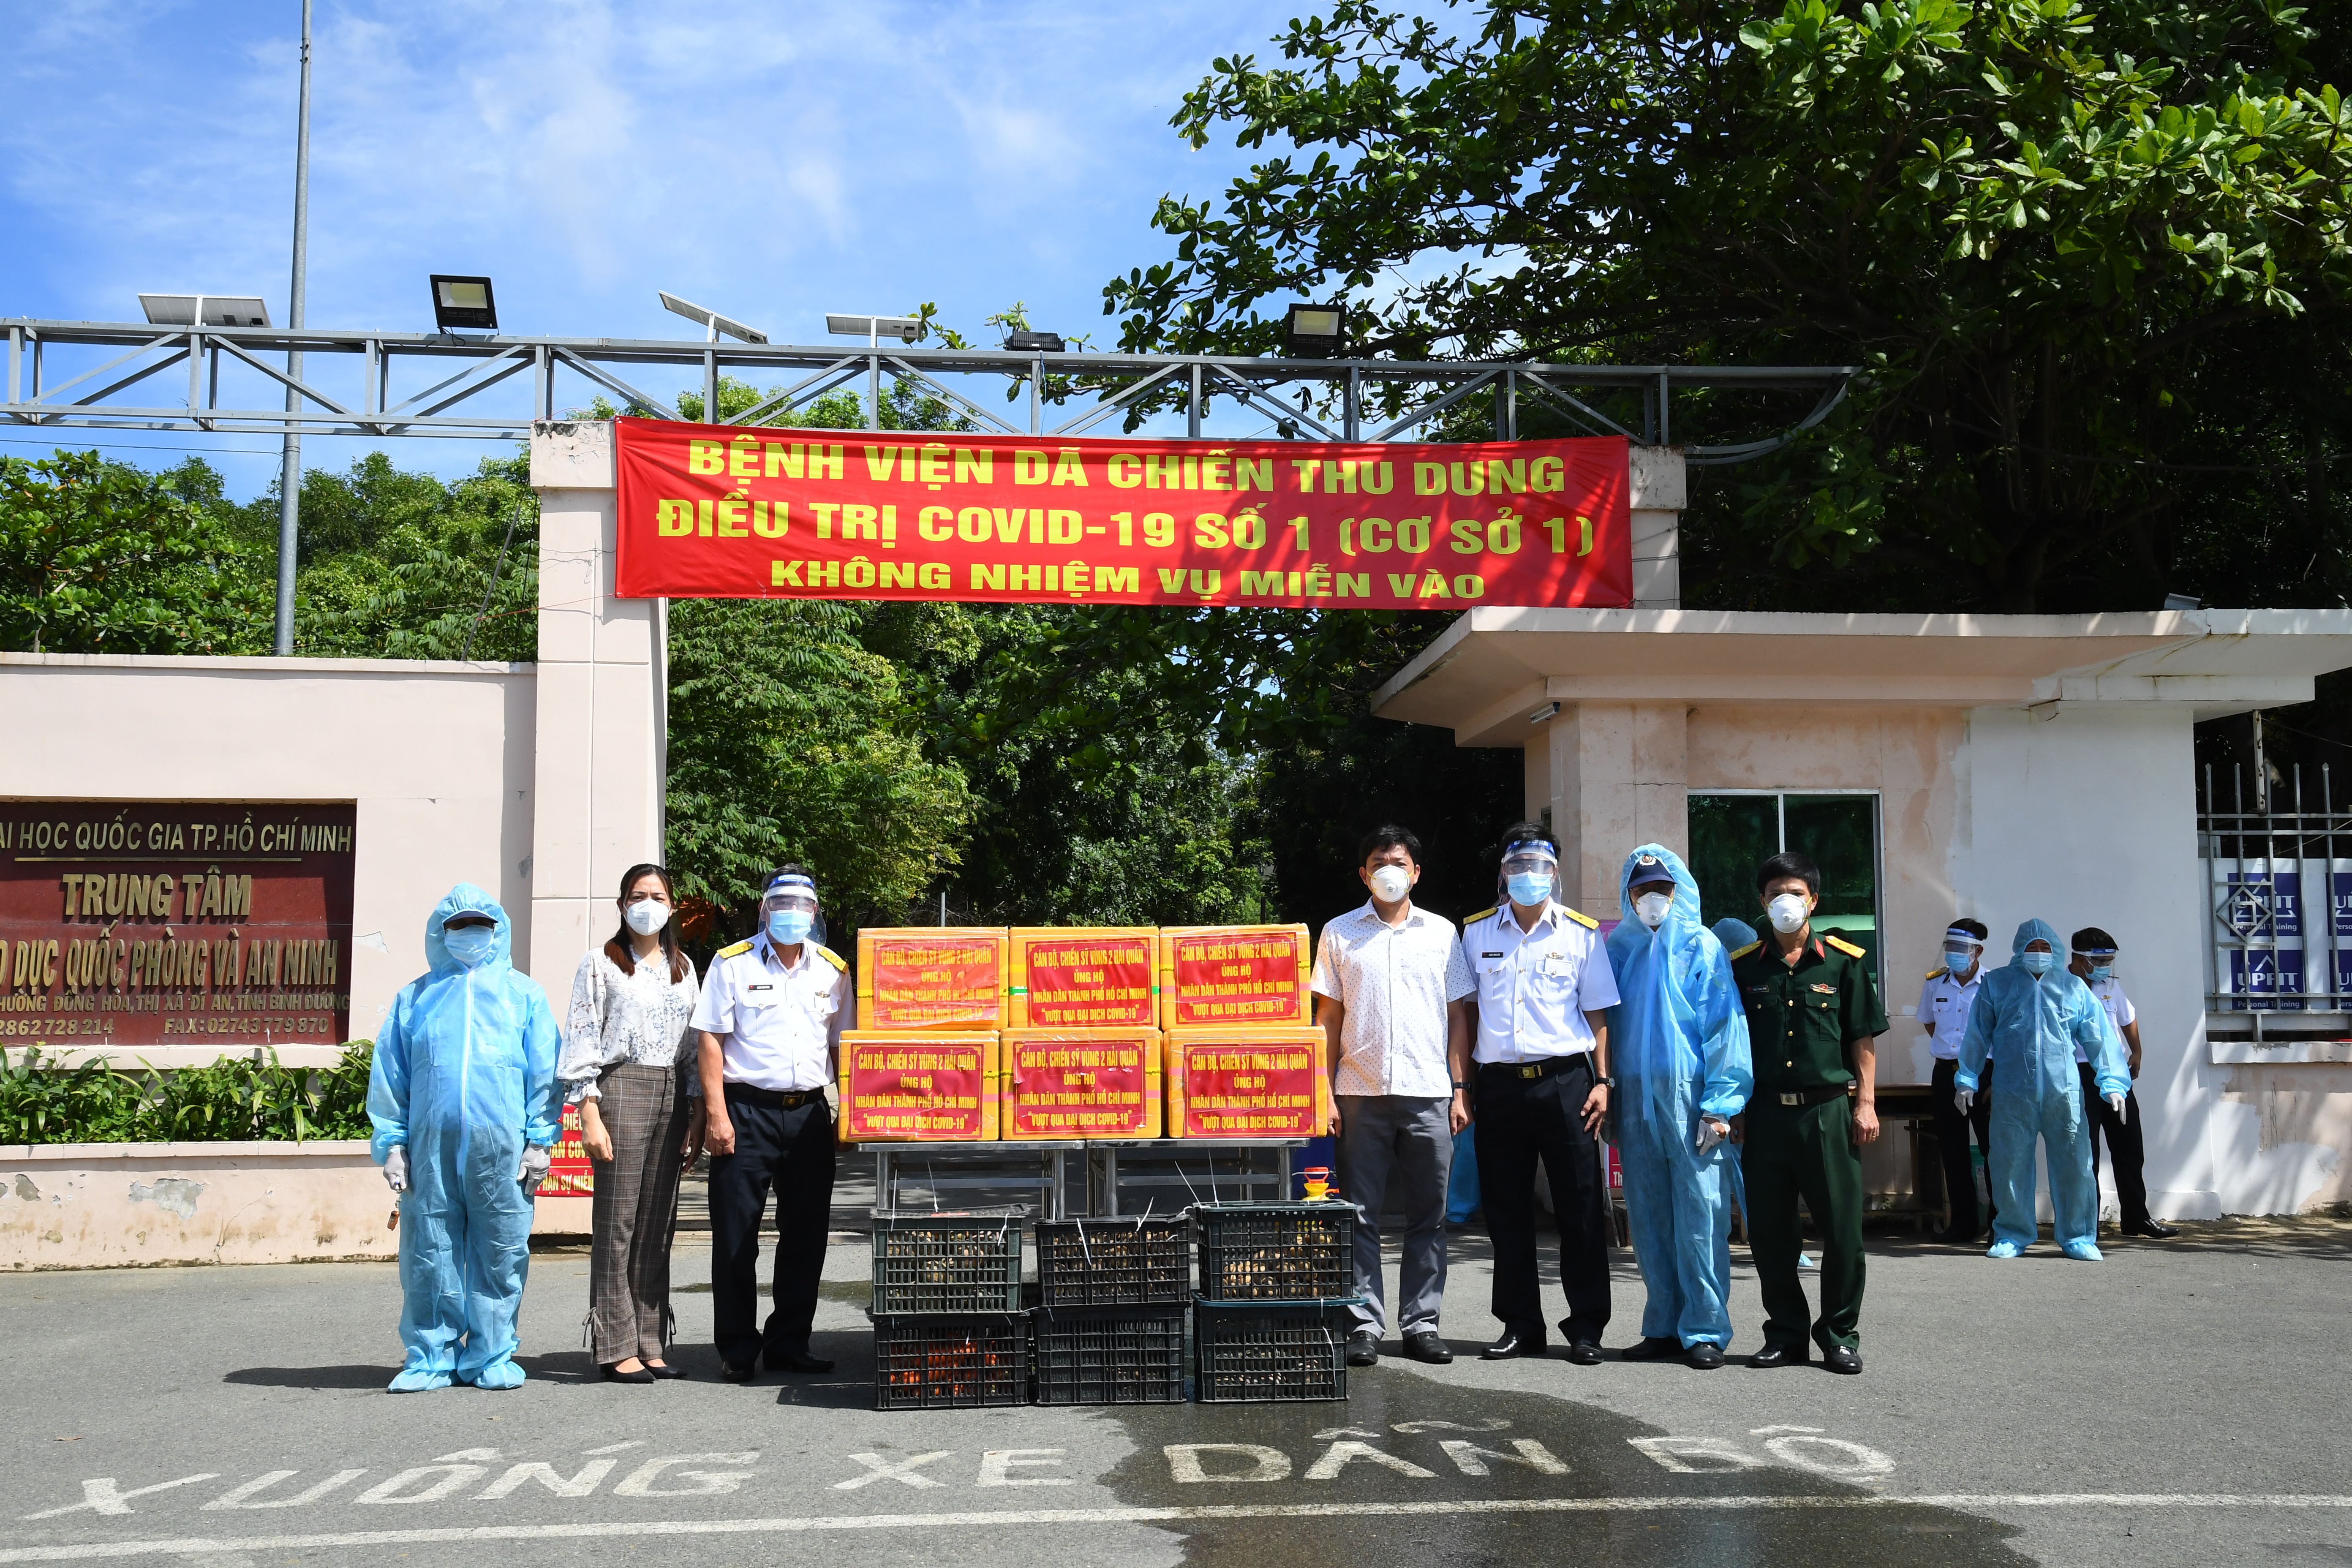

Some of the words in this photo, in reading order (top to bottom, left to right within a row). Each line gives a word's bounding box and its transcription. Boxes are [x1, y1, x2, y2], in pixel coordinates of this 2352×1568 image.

[690, 434, 843, 484] BỆNH
[864, 443, 993, 490] VIỆN
[1015, 446, 1088, 486] DÃ
[1108, 449, 1273, 491] CHIẾN
[1292, 460, 1393, 494] THU
[1414, 457, 1564, 495] DUNG
[656, 490, 788, 538] ĐIỀU
[809, 504, 896, 548] TRỊ
[919, 507, 1174, 547] COVID-19
[1195, 503, 1267, 550] SỐ
[1288, 517, 1309, 550] 1
[1339, 516, 1431, 556] (CƠ
[1451, 507, 1522, 554] SỞ
[1543, 517, 1592, 556] 1)
[772, 556, 950, 589] KHÔNG
[971, 561, 1139, 597] NHIỆM
[1157, 569, 1221, 600] VỤ
[1241, 564, 1370, 597] MIỄN
[1387, 569, 1484, 598] VÀO
[19, 822, 69, 855] HỌC
[76, 808, 143, 850] QUỐC
[148, 822, 184, 850] GIA
[261, 817, 300, 851] CHÍ
[300, 825, 351, 852] MINH
[63, 873, 173, 916] TRUNG
[182, 865, 252, 916] TÂM
[14, 939, 59, 995] DỤC
[66, 919, 125, 994] QUỐC
[131, 927, 207, 986] PHÒNG
[215, 928, 239, 985] VÀ
[245, 940, 279, 985] AN
[284, 939, 338, 985] NINH
[1034, 950, 1047, 967] CÁN
[1048, 949, 1059, 969] BỘ,
[1060, 946, 1079, 966] CHIẾN
[1081, 948, 1089, 966] SỸ
[1090, 947, 1107, 965] VÙNG
[1108, 950, 1112, 964] 2
[1114, 945, 1124, 964] HẢI
[1126, 946, 1143, 966] QUÂN
[1181, 943, 1195, 961] CÁN
[1208, 940, 1227, 961] CHIẾN
[1256, 944, 1259, 958] 2
[1261, 938, 1271, 958] HẢI
[1273, 939, 1290, 958] QUÂN
[1074, 969, 1091, 983] ỦNG
[1093, 969, 1104, 984] HỘ
[1222, 963, 1239, 977] ỦNG
[1241, 963, 1251, 978] HỘ
[270, 987, 302, 1010] BÌNH
[1033, 989, 1051, 1003] NHÂN
[1054, 988, 1067, 1002] DÂN
[1068, 988, 1089, 1002] THÀNH
[1092, 985, 1104, 1001] PHỐ
[1106, 985, 1115, 1000] HỒ
[1116, 986, 1127, 1000] CHÍ
[1129, 988, 1146, 999] MINH
[1181, 983, 1199, 996] NHÂN
[1201, 983, 1214, 996] DÂN
[1216, 982, 1237, 996] THÀNH
[1239, 979, 1252, 994] PHỐ
[1264, 980, 1275, 993] CHÍ
[1276, 981, 1293, 993] MINH
[1063, 1010, 1076, 1022] QUA
[1077, 1010, 1088, 1023] ĐẠI
[1090, 1009, 1105, 1022] DỊCH
[1211, 1003, 1224, 1016] QUA
[1225, 1003, 1236, 1017] ĐẠI
[1238, 1002, 1253, 1016] DỊCH
[1021, 1049, 1035, 1067] CÁN
[1037, 1048, 1048, 1070] BỘ,
[1050, 1046, 1070, 1067] CHIẾN
[1071, 1048, 1079, 1067] SỸ
[1081, 1048, 1099, 1066] VÙNG
[1101, 1051, 1105, 1066] 2
[1107, 1045, 1118, 1066] HẢI
[1119, 1048, 1138, 1068] QUÂN
[1192, 1052, 1206, 1070] CÁN
[1208, 1051, 1218, 1073] BỘ,
[1220, 1049, 1240, 1070] CHIẾN
[1241, 1051, 1250, 1070] SỸ
[1251, 1051, 1269, 1070] VÙNG
[1271, 1054, 1275, 1070] 2
[1277, 1048, 1288, 1070] HẢI
[1290, 1051, 1307, 1071] QUÂN
[1064, 1070, 1081, 1085] ỦNG
[1084, 1071, 1095, 1087] HỘ
[1234, 1073, 1252, 1088] ỦNG
[1254, 1075, 1266, 1090] HỘ
[1190, 1094, 1209, 1108] NHÂN
[1211, 1094, 1226, 1108] DÂN
[1228, 1094, 1250, 1108] THÀNH
[1252, 1092, 1266, 1108] PHỐ
[1268, 1092, 1277, 1108] HỒ
[1278, 1093, 1290, 1107] CHÍ
[1292, 1095, 1309, 1107] MINH
[1222, 1116, 1235, 1130] QUA
[1237, 1116, 1248, 1131] ĐẠI
[1250, 1116, 1266, 1130] DỊCH
[561, 1173, 572, 1194] SỰ
[573, 1169, 594, 1191] MIỄN
[833, 1449, 1071, 1490] XE
[1163, 1419, 1572, 1483] DẪN
[1627, 1424, 1896, 1484] BỘ
